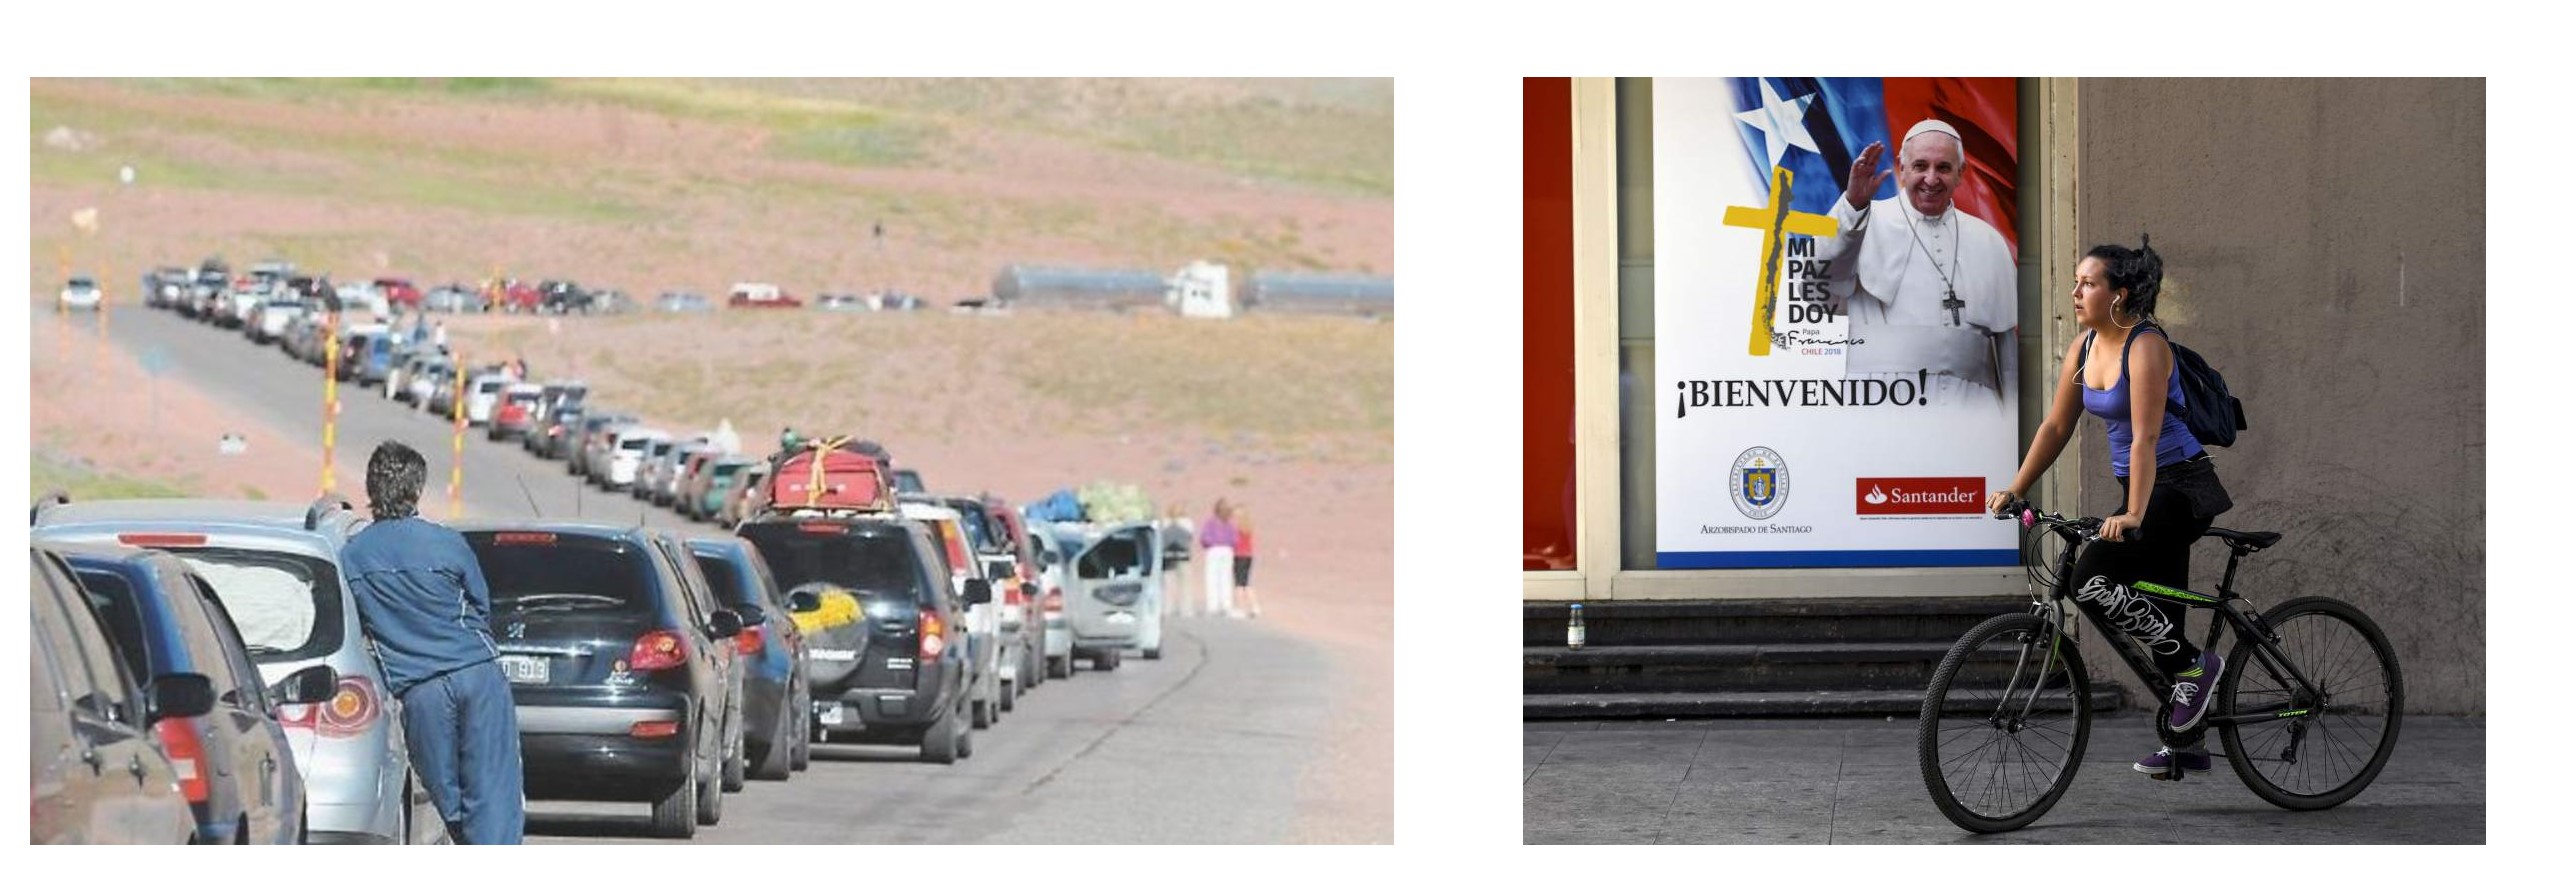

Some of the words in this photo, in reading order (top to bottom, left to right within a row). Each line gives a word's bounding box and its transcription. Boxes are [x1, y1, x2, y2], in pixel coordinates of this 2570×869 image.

[1787, 237, 1816, 258] MI
[1787, 259, 1832, 280] PAZ
[1787, 281, 1831, 302] LES
[1787, 303, 1838, 324] DOY
[1802, 328, 1820, 336] Papa
[1801, 348, 1823, 356] CHILE
[1824, 348, 1842, 356] 2018
[1677, 368, 1928, 419] ¡BIENVENIDO!
[1890, 486, 1978, 504] Santander
[1757, 525, 1769, 534] DE
[1770, 523, 1813, 534] SANTIAGO
